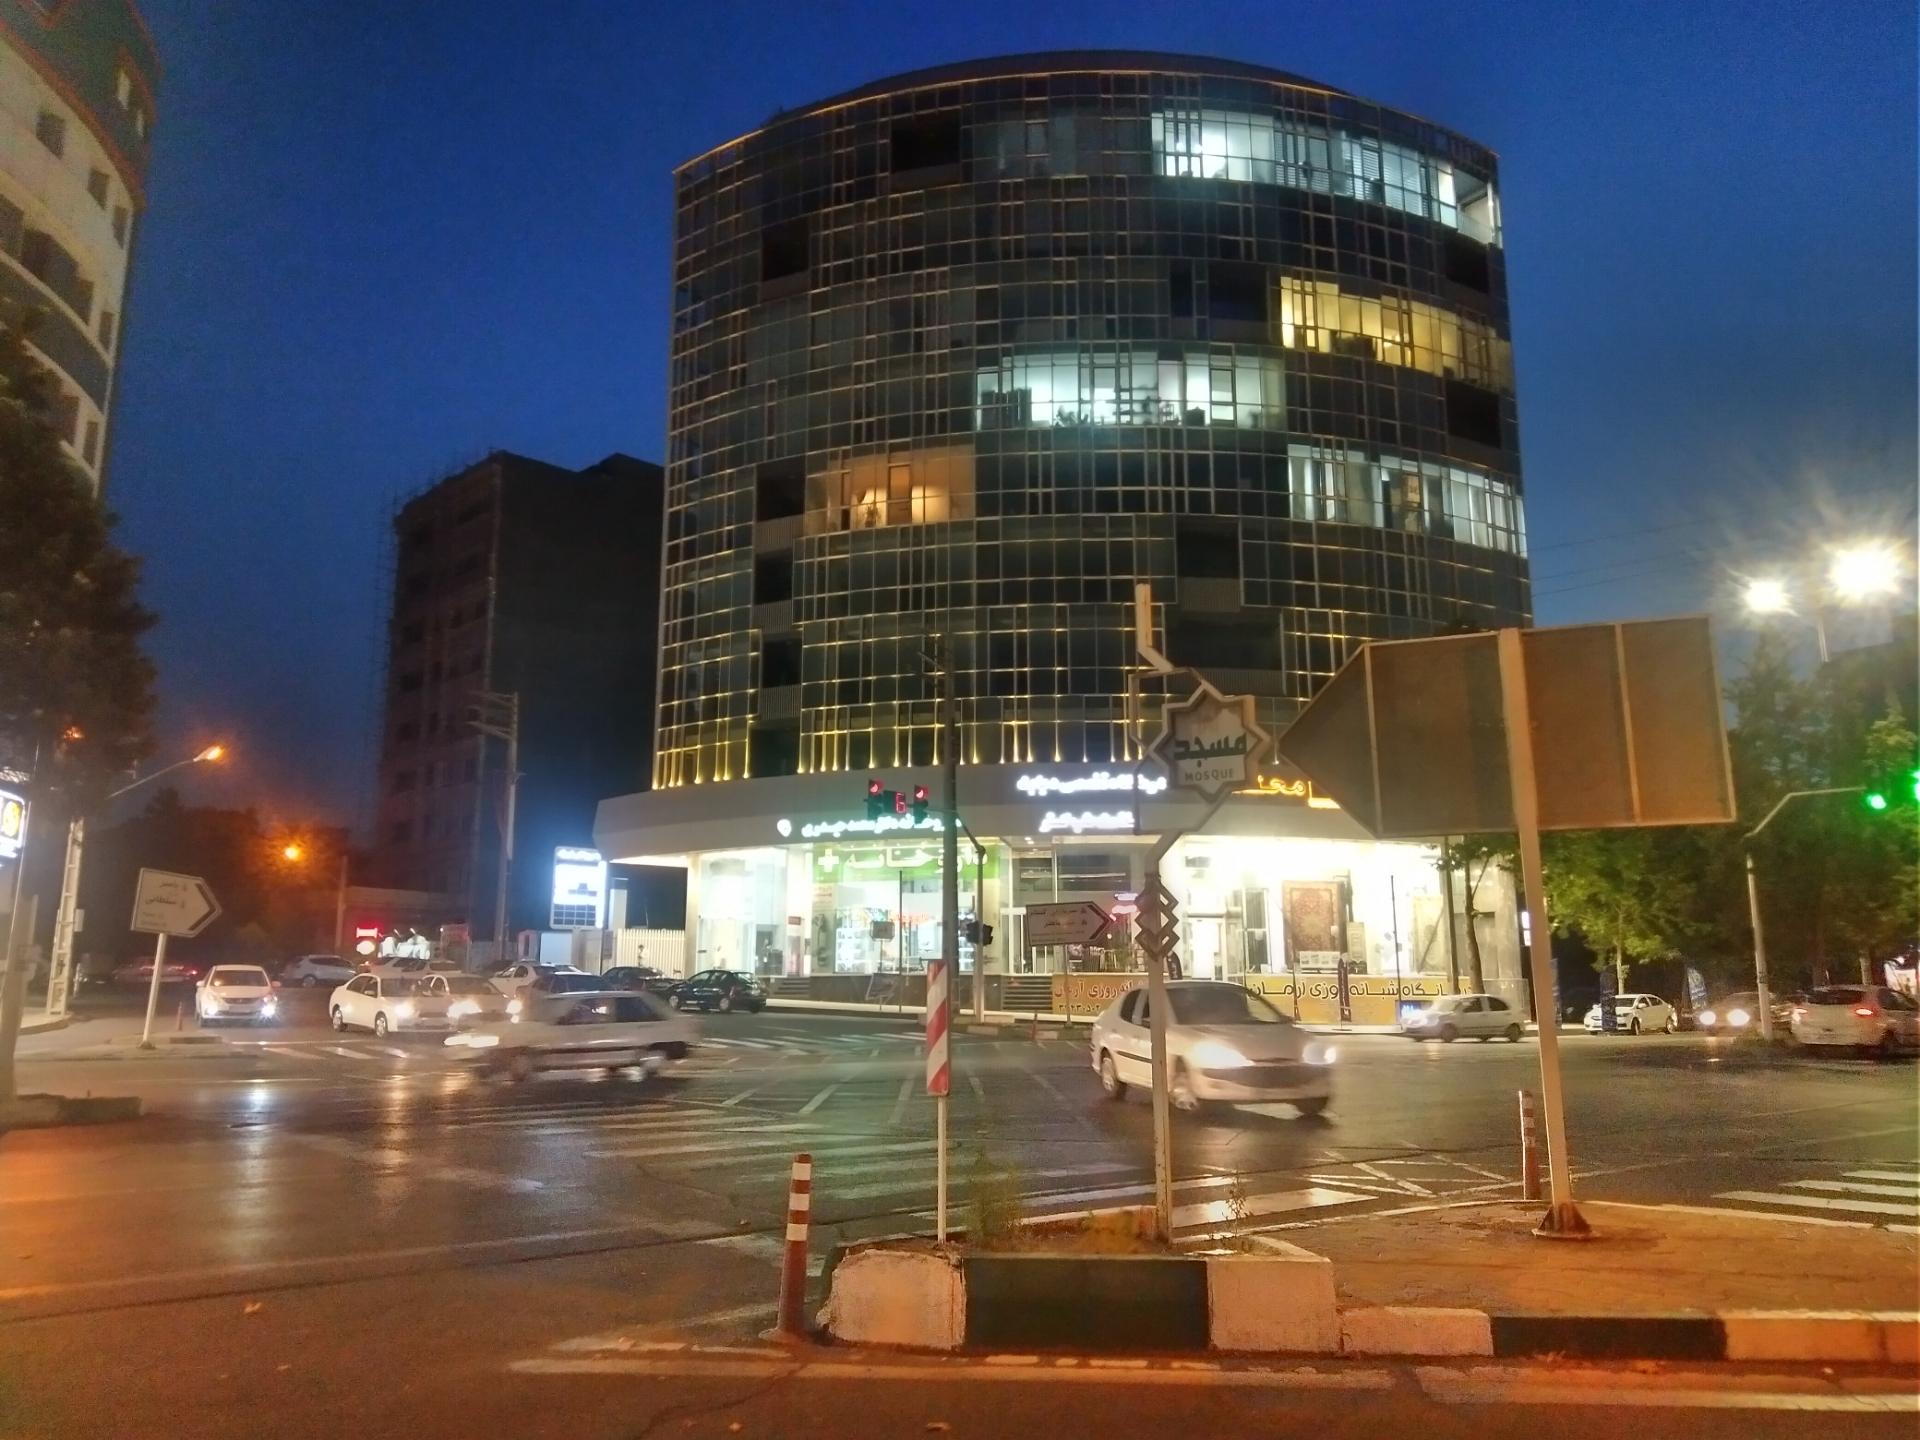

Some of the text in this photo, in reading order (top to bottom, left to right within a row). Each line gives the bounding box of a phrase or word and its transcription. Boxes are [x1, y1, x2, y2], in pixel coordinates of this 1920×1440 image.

[1185, 768, 1234, 782] MOSQUE
[896, 791, 905, 814] 6
[1054, 979, 1084, 998] آران
[1309, 983, 1339, 999] وزی
[1349, 980, 1398, 1000] شبانه
